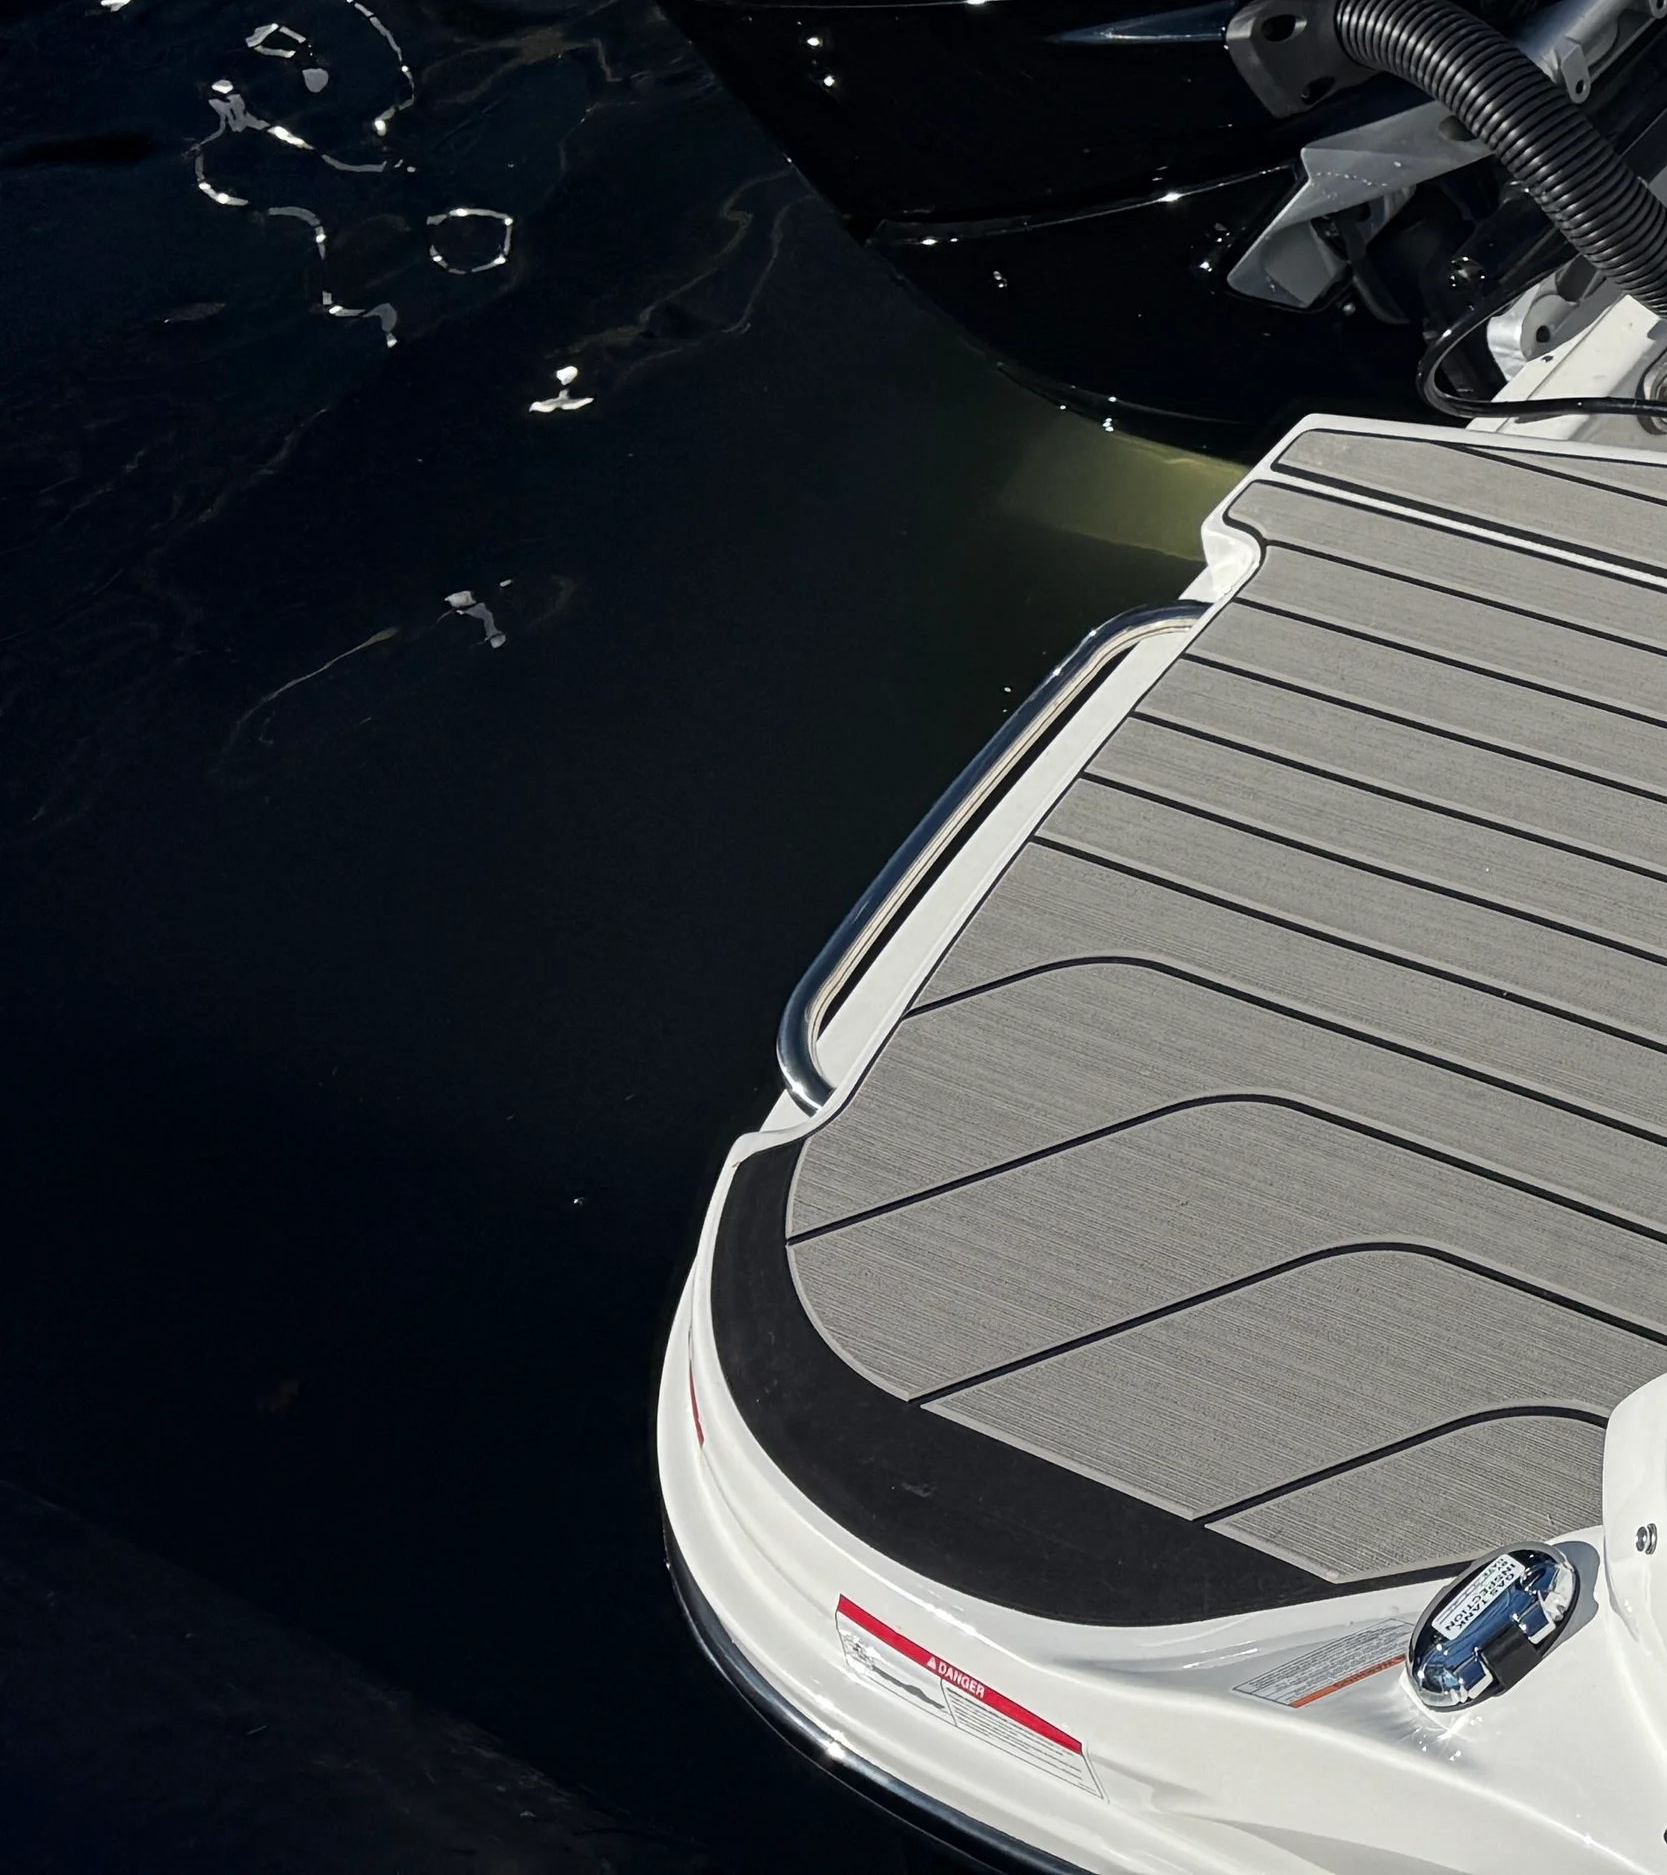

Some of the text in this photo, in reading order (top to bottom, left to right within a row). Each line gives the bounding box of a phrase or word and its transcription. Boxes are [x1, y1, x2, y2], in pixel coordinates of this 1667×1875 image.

[1445, 1563, 1516, 1631] INSPECTION
[1456, 1573, 1515, 1629] GAS TANK
[938, 1662, 985, 1699] DANGER
